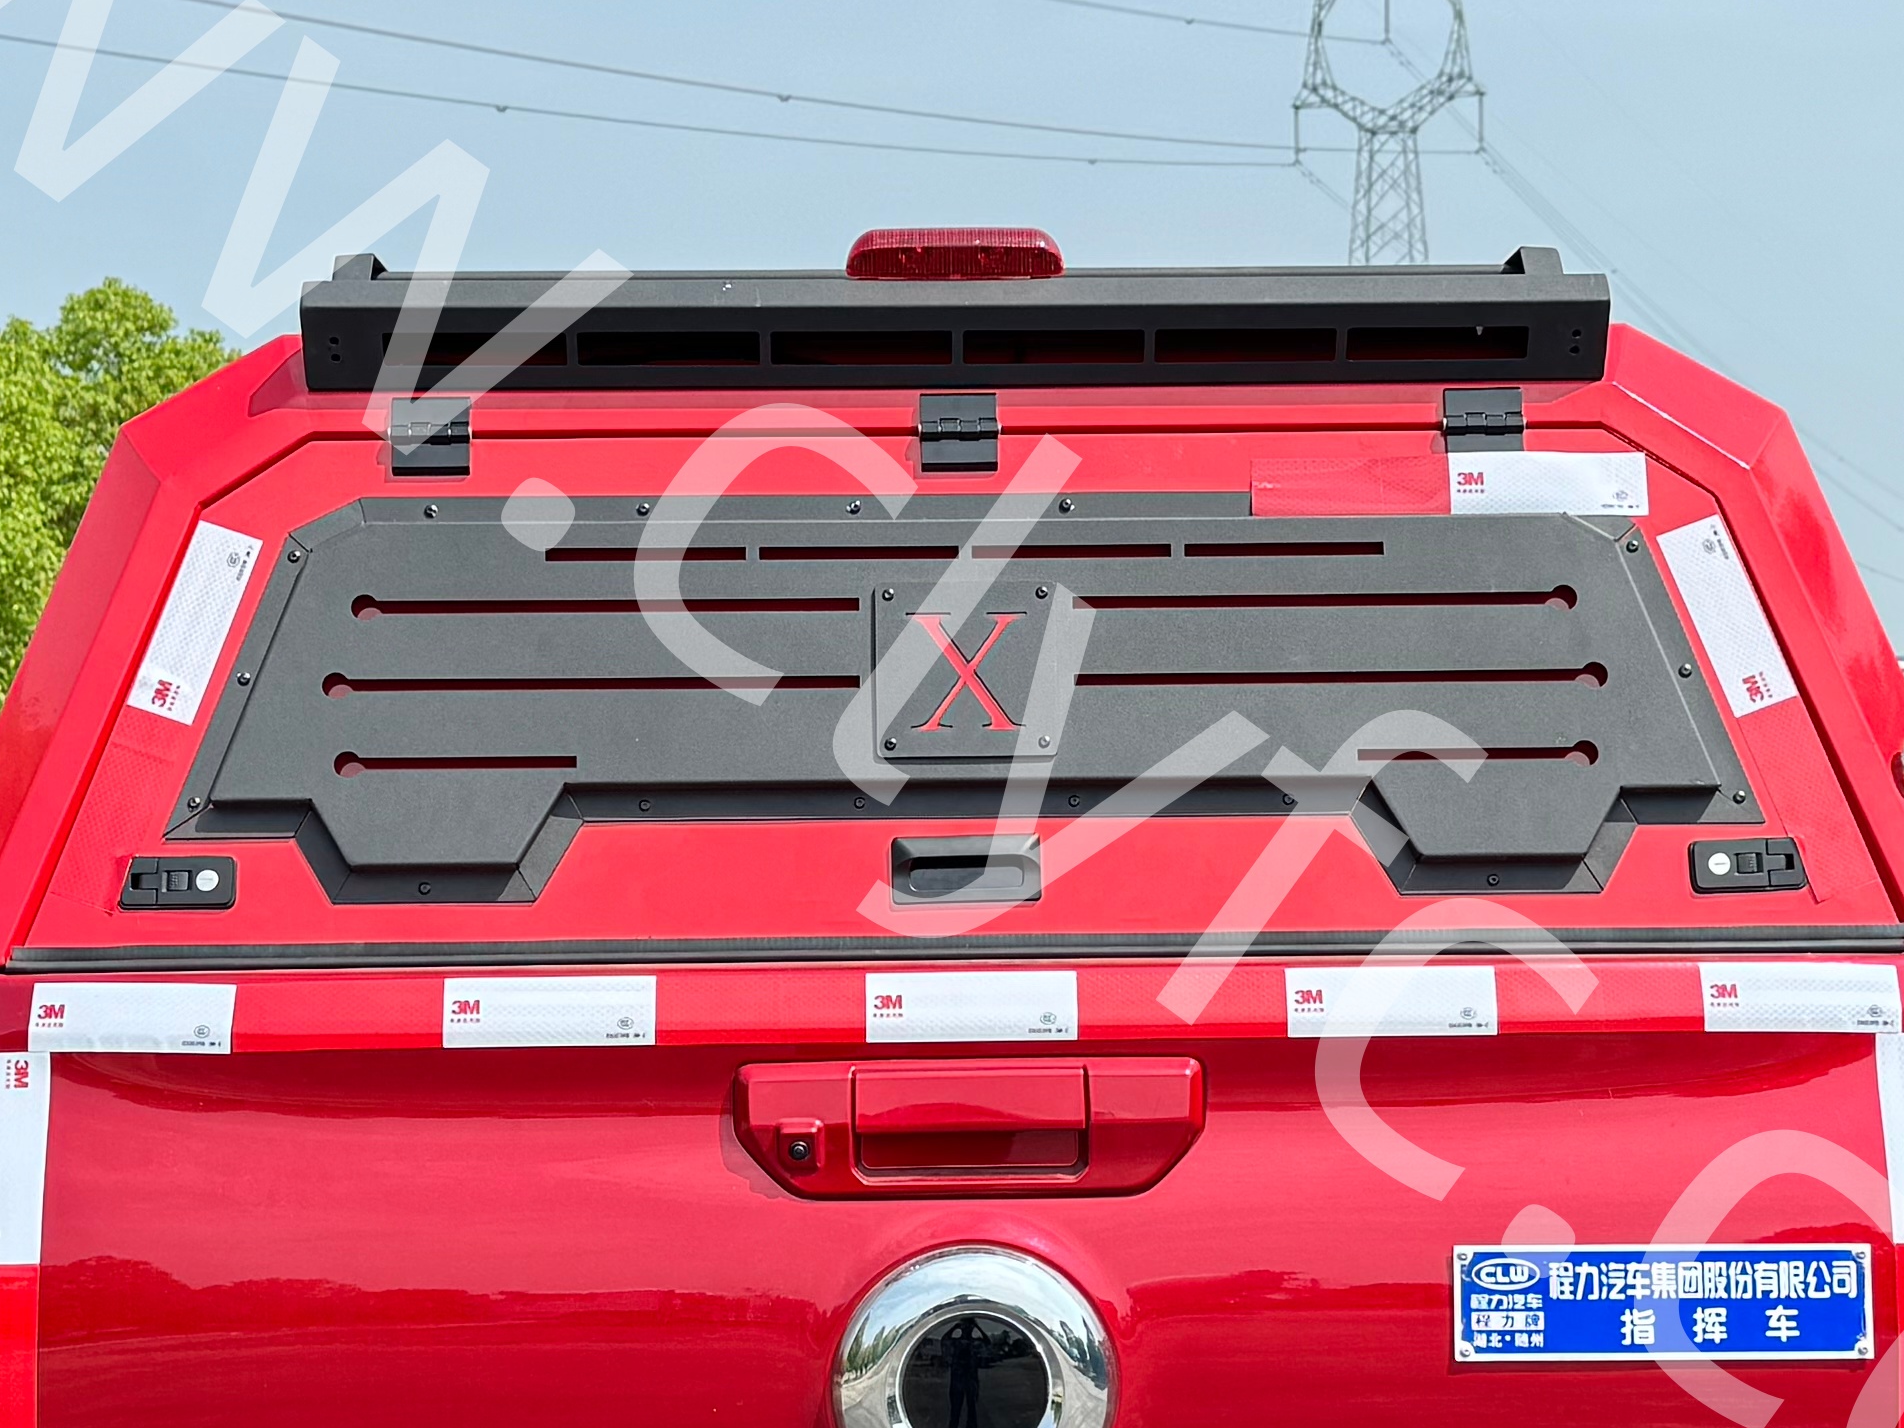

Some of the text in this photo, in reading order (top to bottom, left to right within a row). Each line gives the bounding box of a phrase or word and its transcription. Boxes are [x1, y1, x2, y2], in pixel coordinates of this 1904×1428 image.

[1457, 471, 1485, 487] 3M
[905, 611, 1028, 732] X
[151, 679, 173, 708] 3M
[1741, 674, 1765, 704] 3M
[1294, 989, 1324, 1005] 3M
[1709, 983, 1739, 1000] 3M
[37, 1003, 66, 1019] 3M
[451, 999, 481, 1015] 3M
[873, 994, 903, 1011] 3M
[13, 1059, 30, 1089] 3M
[1480, 1266, 1529, 1283] CLW
[1549, 1260, 1858, 1300] 程力汽车集团股份有限公司
[1620, 1305, 1800, 1346] 指挥车
